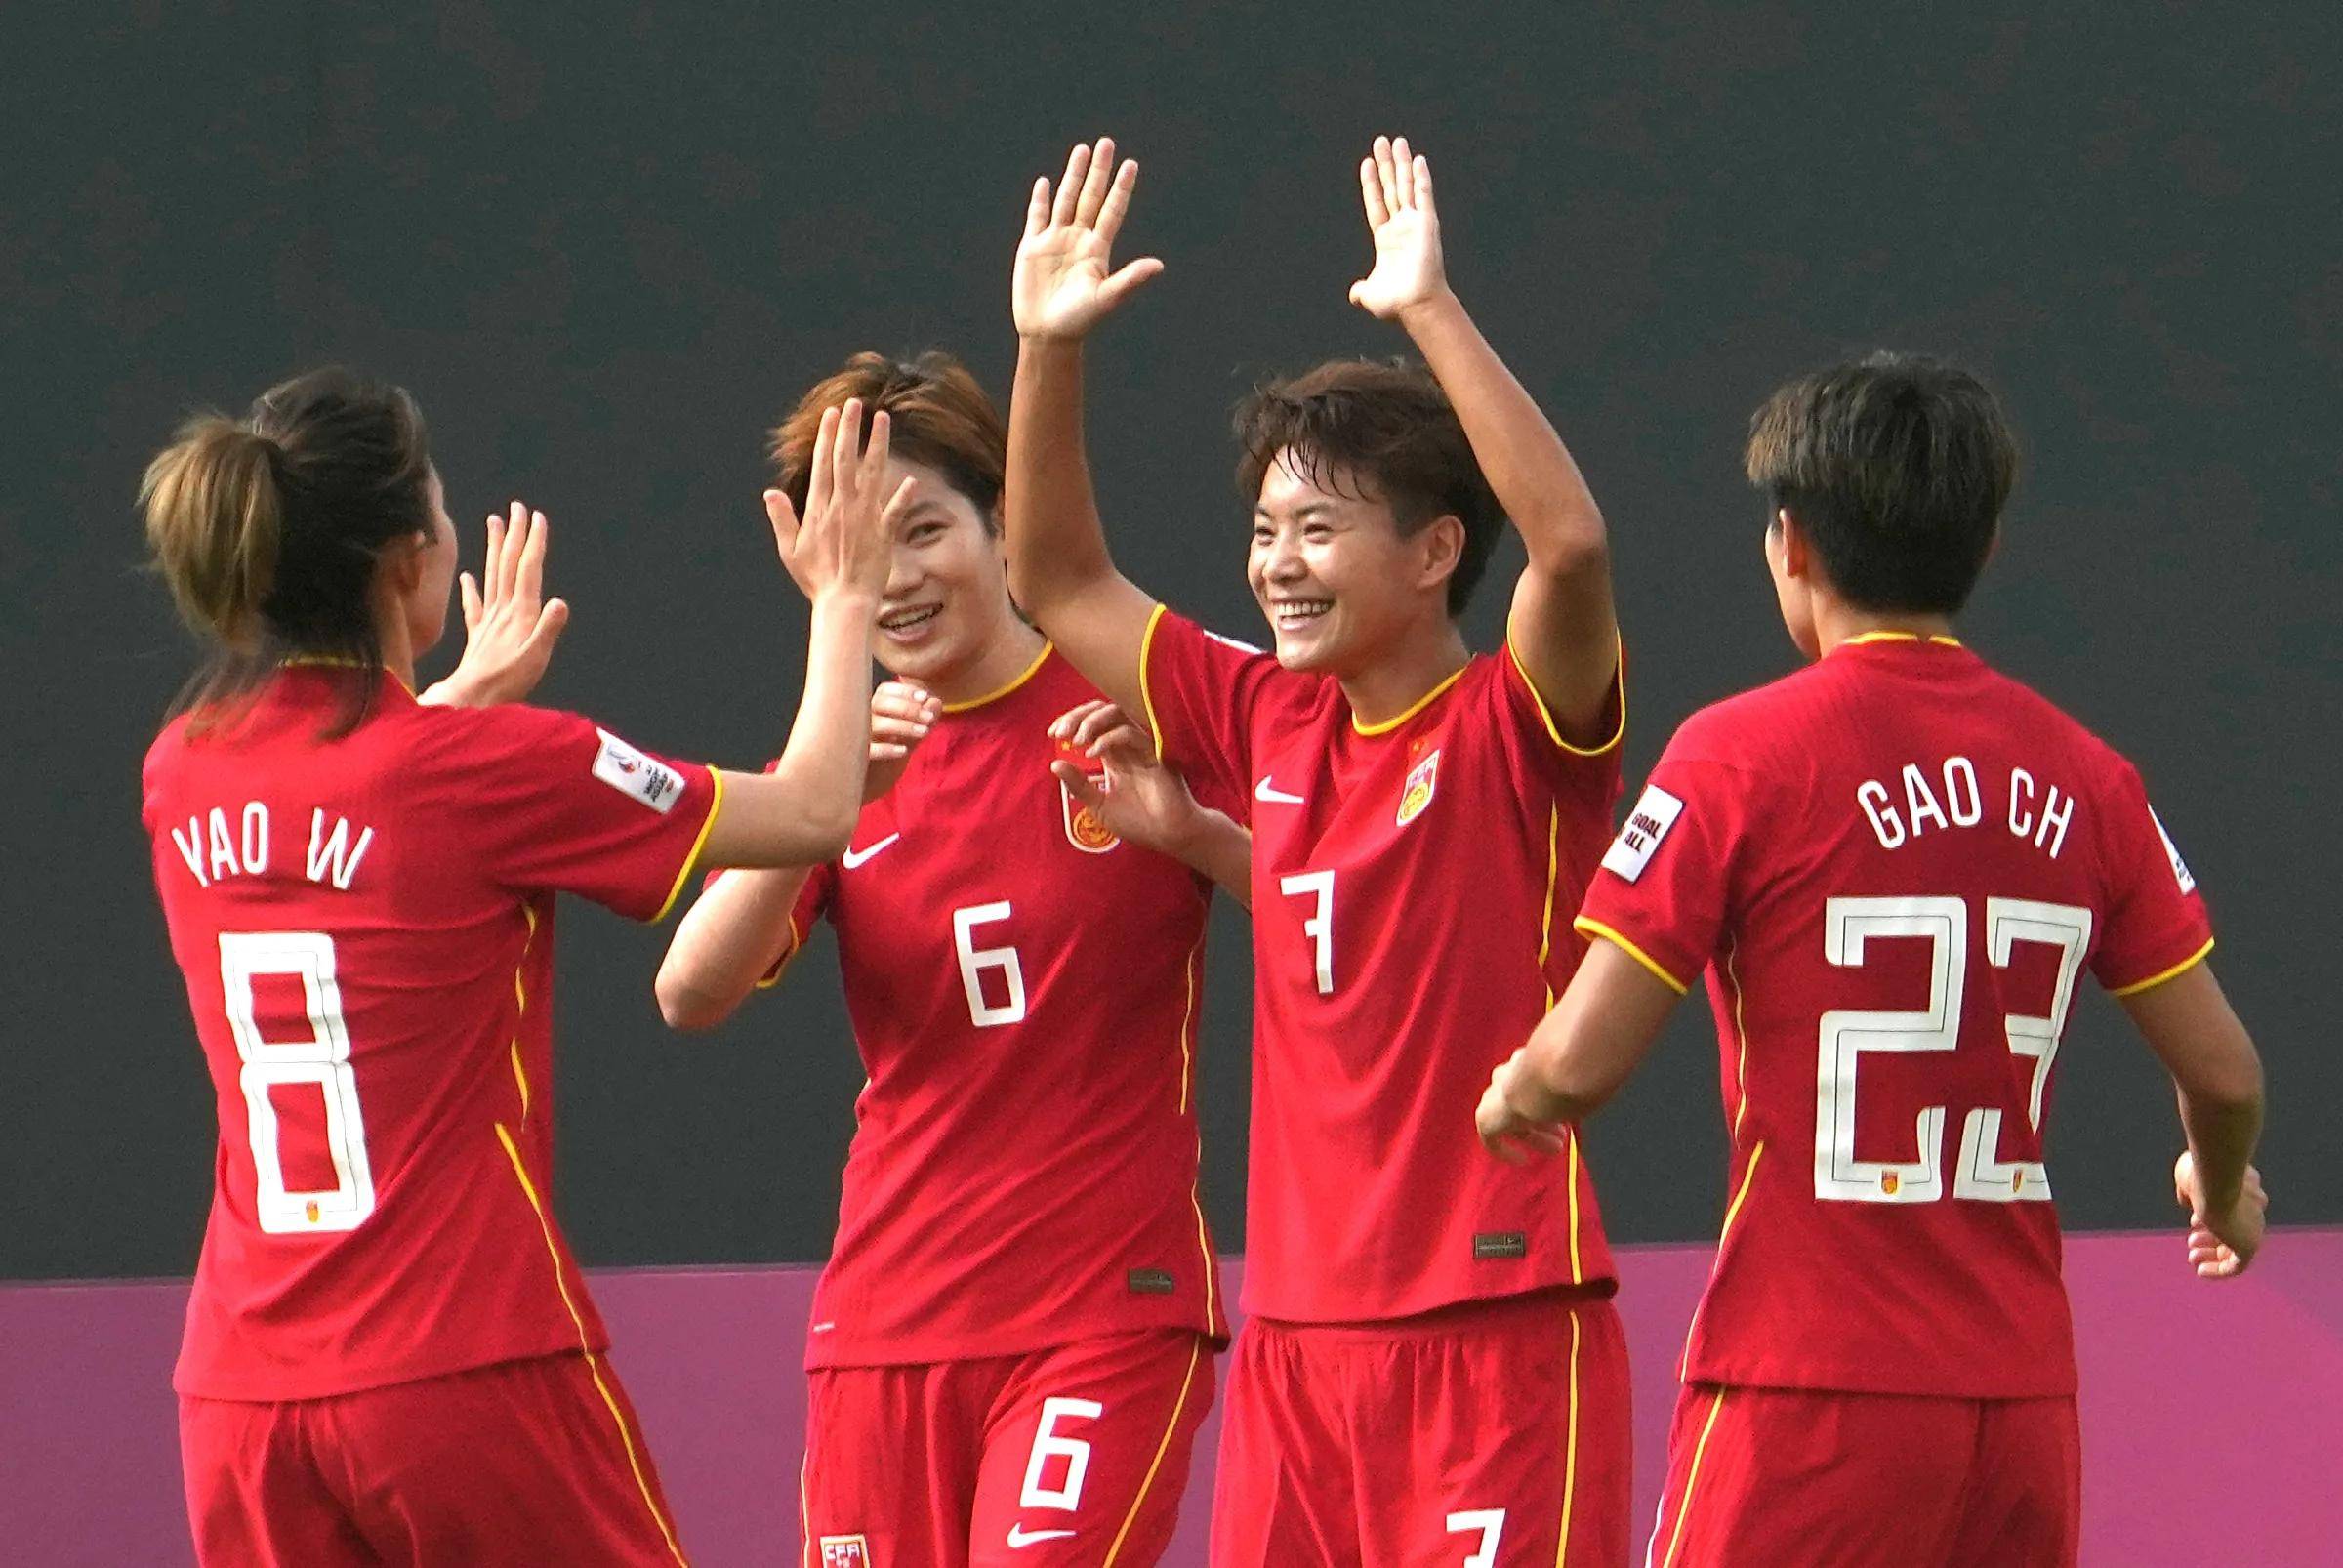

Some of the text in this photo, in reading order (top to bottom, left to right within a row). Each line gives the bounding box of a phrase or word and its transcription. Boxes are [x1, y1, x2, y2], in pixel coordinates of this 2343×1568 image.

[171, 800, 375, 890] YAO W
[1625, 831, 1644, 852] ALL
[1632, 812, 1662, 839] GOAL
[1857, 756, 2074, 859] GAO CH
[953, 900, 1026, 1027] 6
[1280, 868, 1336, 994] 7
[218, 930, 377, 1235] 8
[1813, 895, 2093, 1204] 23
[1019, 1396, 1103, 1510] 6
